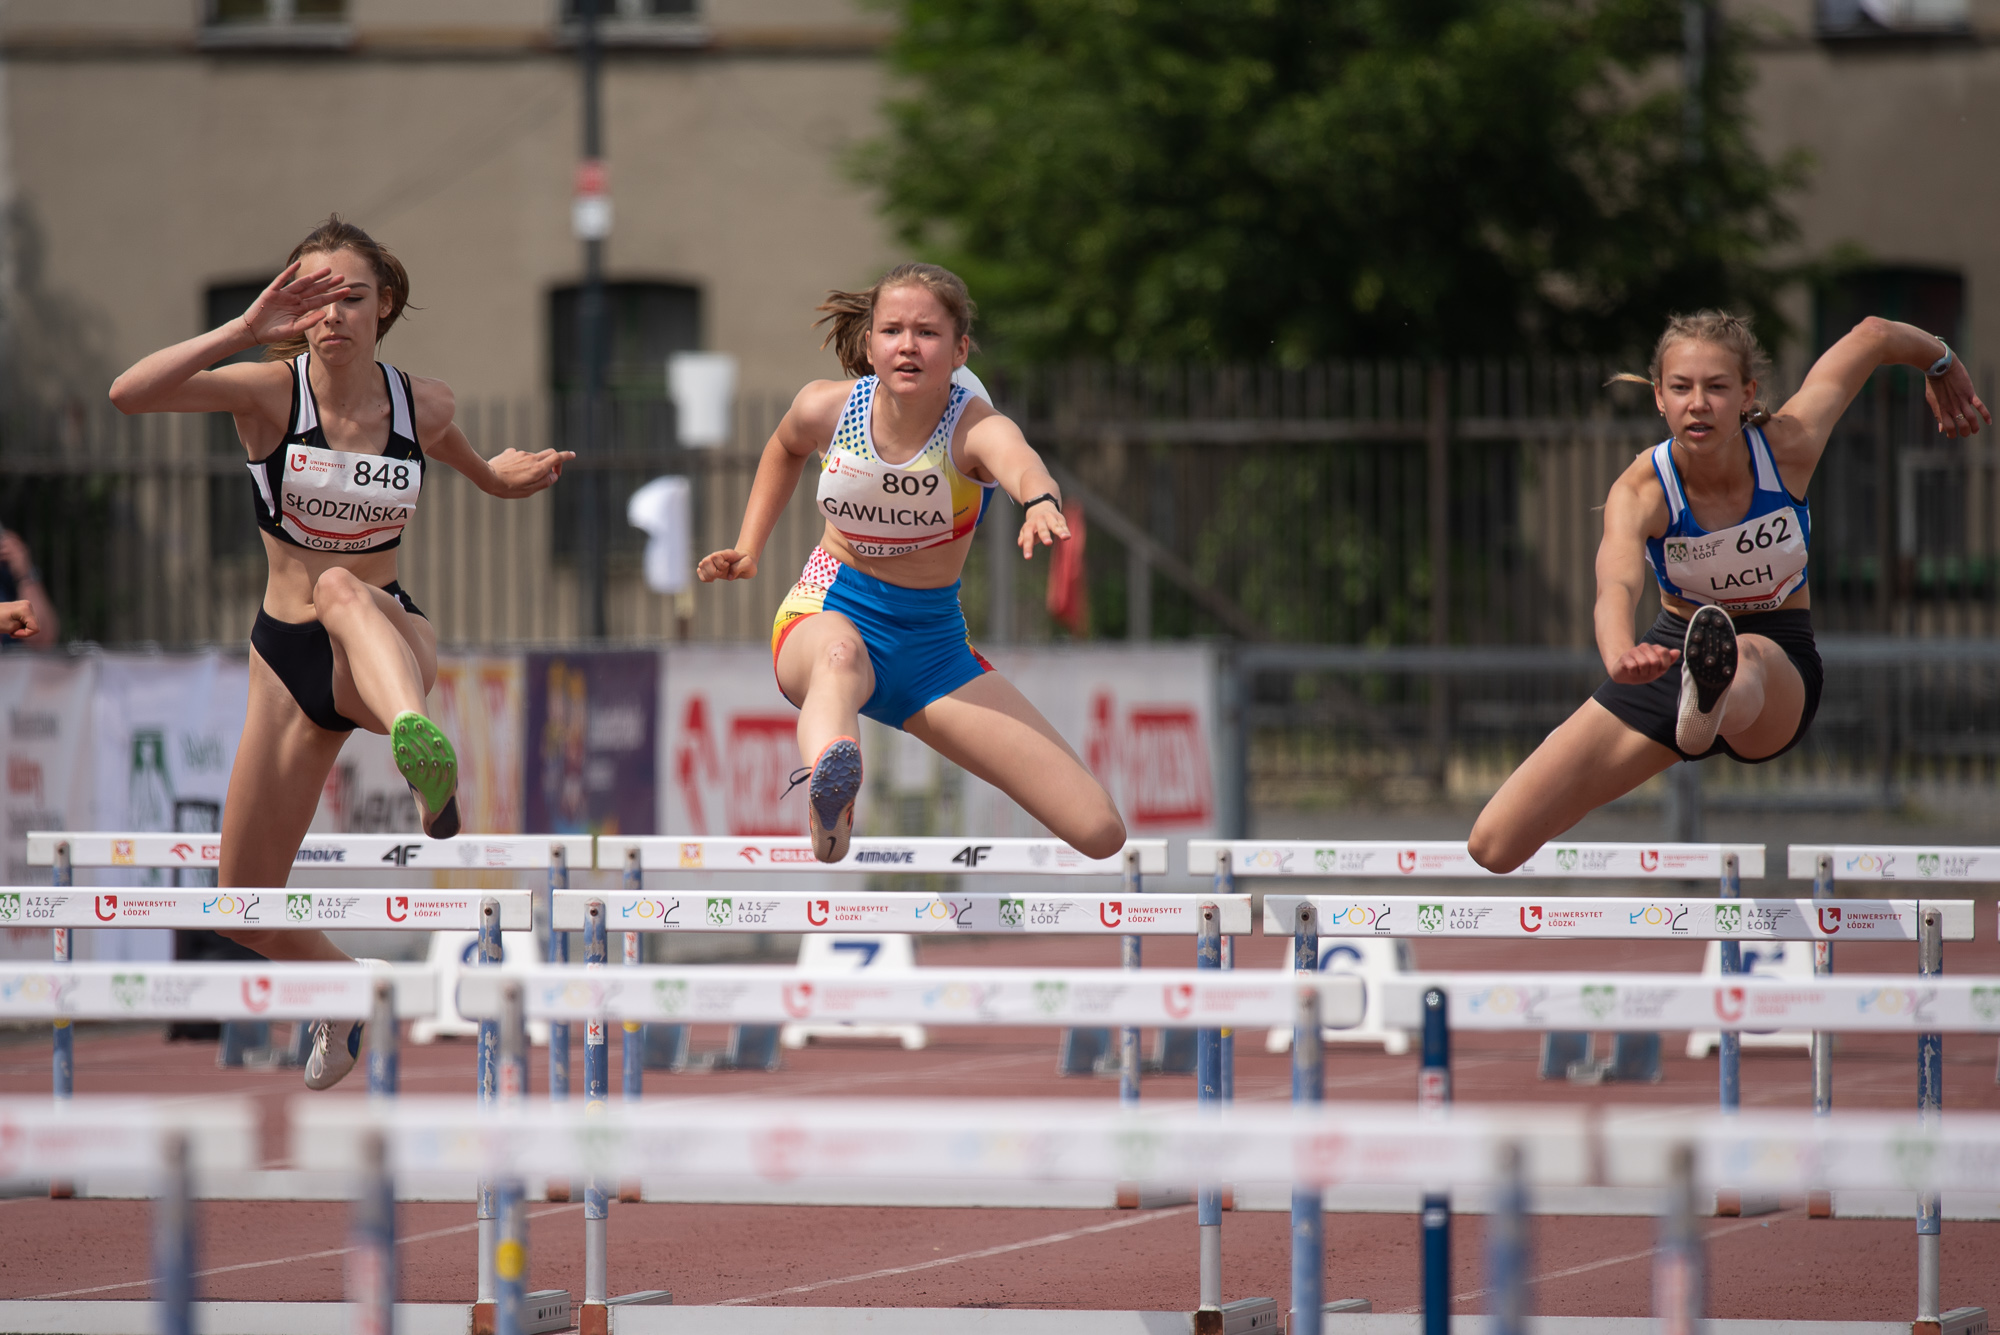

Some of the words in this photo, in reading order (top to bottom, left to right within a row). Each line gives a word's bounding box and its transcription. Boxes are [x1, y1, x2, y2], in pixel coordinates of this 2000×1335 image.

[310, 460, 346, 469] UNIWERSYTET
[353, 460, 410, 490] 848
[841, 464, 874, 478] UNIWERSYTET
[882, 473, 939, 496] 809
[285, 492, 408, 523] SŁODZIŃSKA
[823, 497, 947, 527] GAWLICKA
[1736, 516, 1792, 554] 662
[305, 536, 340, 550] ŁÓDŹ
[343, 537, 372, 551] 2021
[854, 542, 885, 556] ÓDŹ
[888, 544, 919, 556] 2021
[1710, 564, 1774, 591] LACH
[1752, 595, 1782, 610] 2021
[381, 845, 422, 866] 4F
[951, 846, 993, 867] 4F
[26, 897, 50, 906] AZS
[318, 897, 341, 907] AZS
[738, 901, 762, 911] AZS
[1031, 903, 1055, 912] AZS
[26, 906, 55, 918] ŁÓDŹ
[123, 908, 150, 916] ŁÓDZKI
[317, 907, 347, 919] ŁÓDŹ
[834, 905, 889, 913] UNIWERSYTET
[1127, 907, 1182, 915] UNIWERSYTET
[1450, 908, 1474, 917] AZS
[1548, 911, 1604, 919] UNIWERSYTET
[1747, 909, 1772, 918] AZS
[738, 911, 767, 923] ŁÓDŹ
[834, 913, 862, 921] ŁÓDZKI
[1030, 912, 1060, 925] ŁÓDŹ
[1127, 915, 1155, 923] ŁÓDZKI
[1847, 912, 1902, 921] UNIWERSYTET
[1450, 917, 1479, 929] ŁÓDŹ
[1548, 919, 1576, 927] ŁÓDZKI
[1747, 918, 1777, 930] ŁÓDŹ
[1846, 921, 1875, 929] ŁÓDZKI
